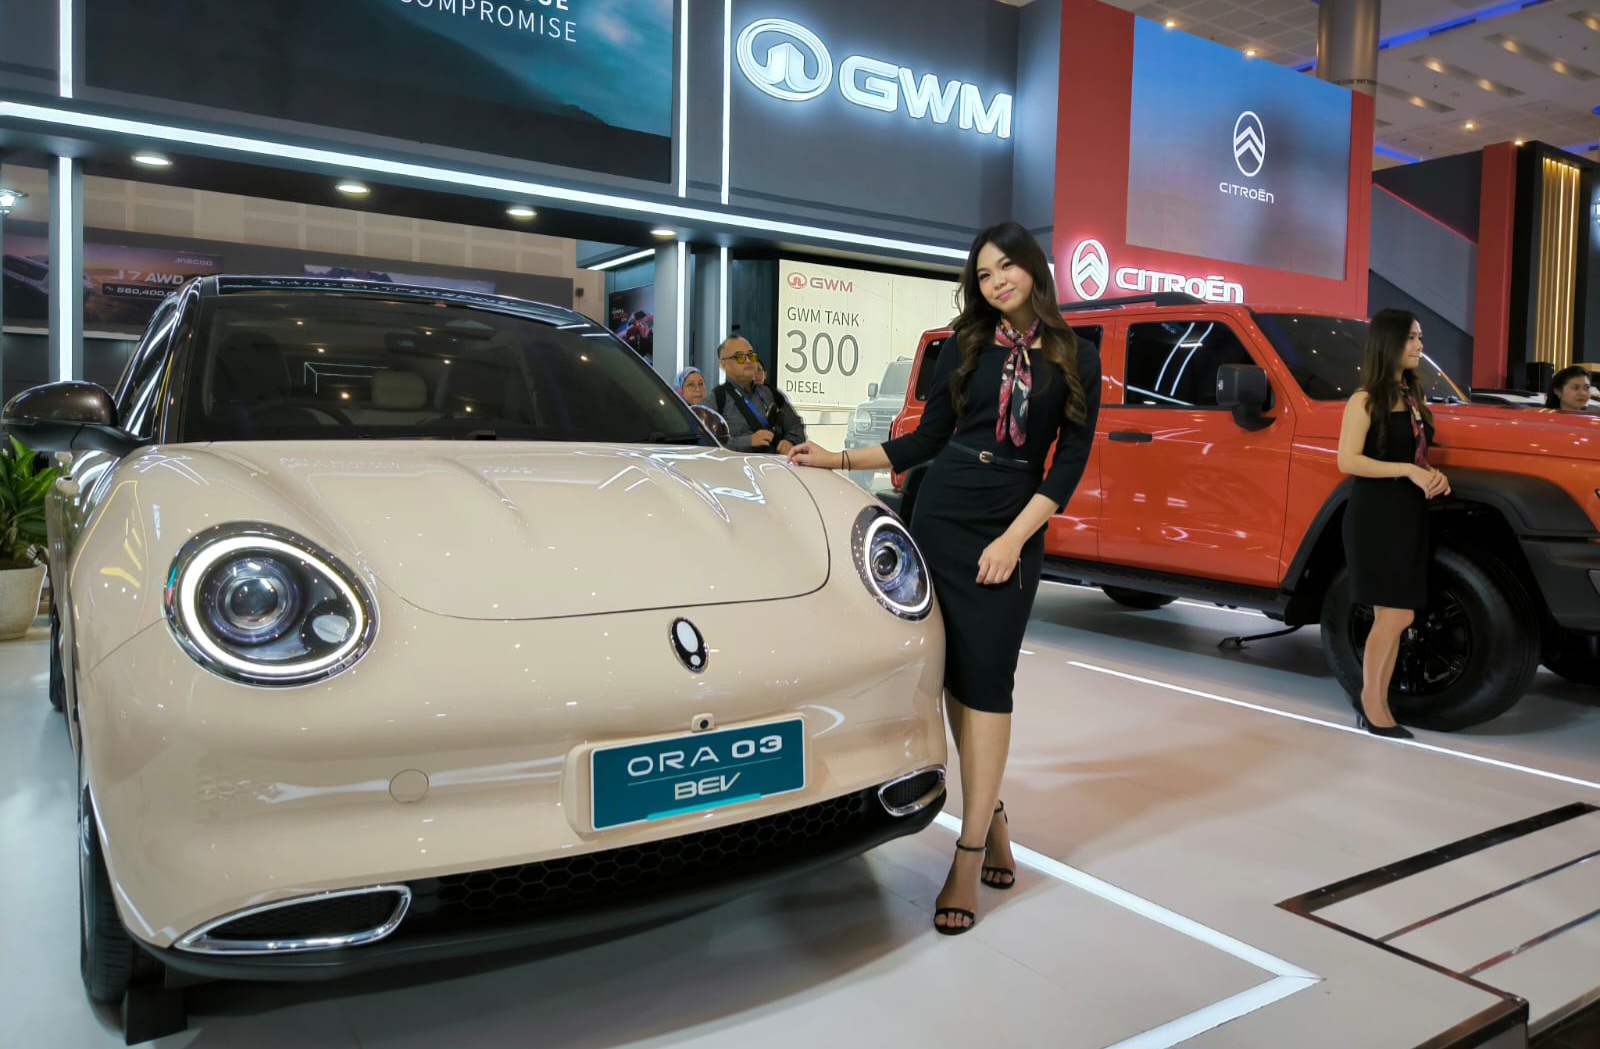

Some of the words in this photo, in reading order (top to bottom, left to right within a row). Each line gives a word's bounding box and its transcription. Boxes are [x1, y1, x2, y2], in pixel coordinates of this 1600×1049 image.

[402, 0, 577, 43] MPROMISE
[839, 55, 1012, 139] GWM
[144, 272, 185, 285] AWD
[809, 276, 853, 293] GWM
[787, 306, 821, 324] GWM
[825, 310, 860, 327] TANK
[785, 329, 859, 377] 300
[786, 380, 825, 394] DIESEL
[627, 746, 720, 777] ORA
[731, 735, 783, 759] 03
[674, 771, 742, 800] BEV
